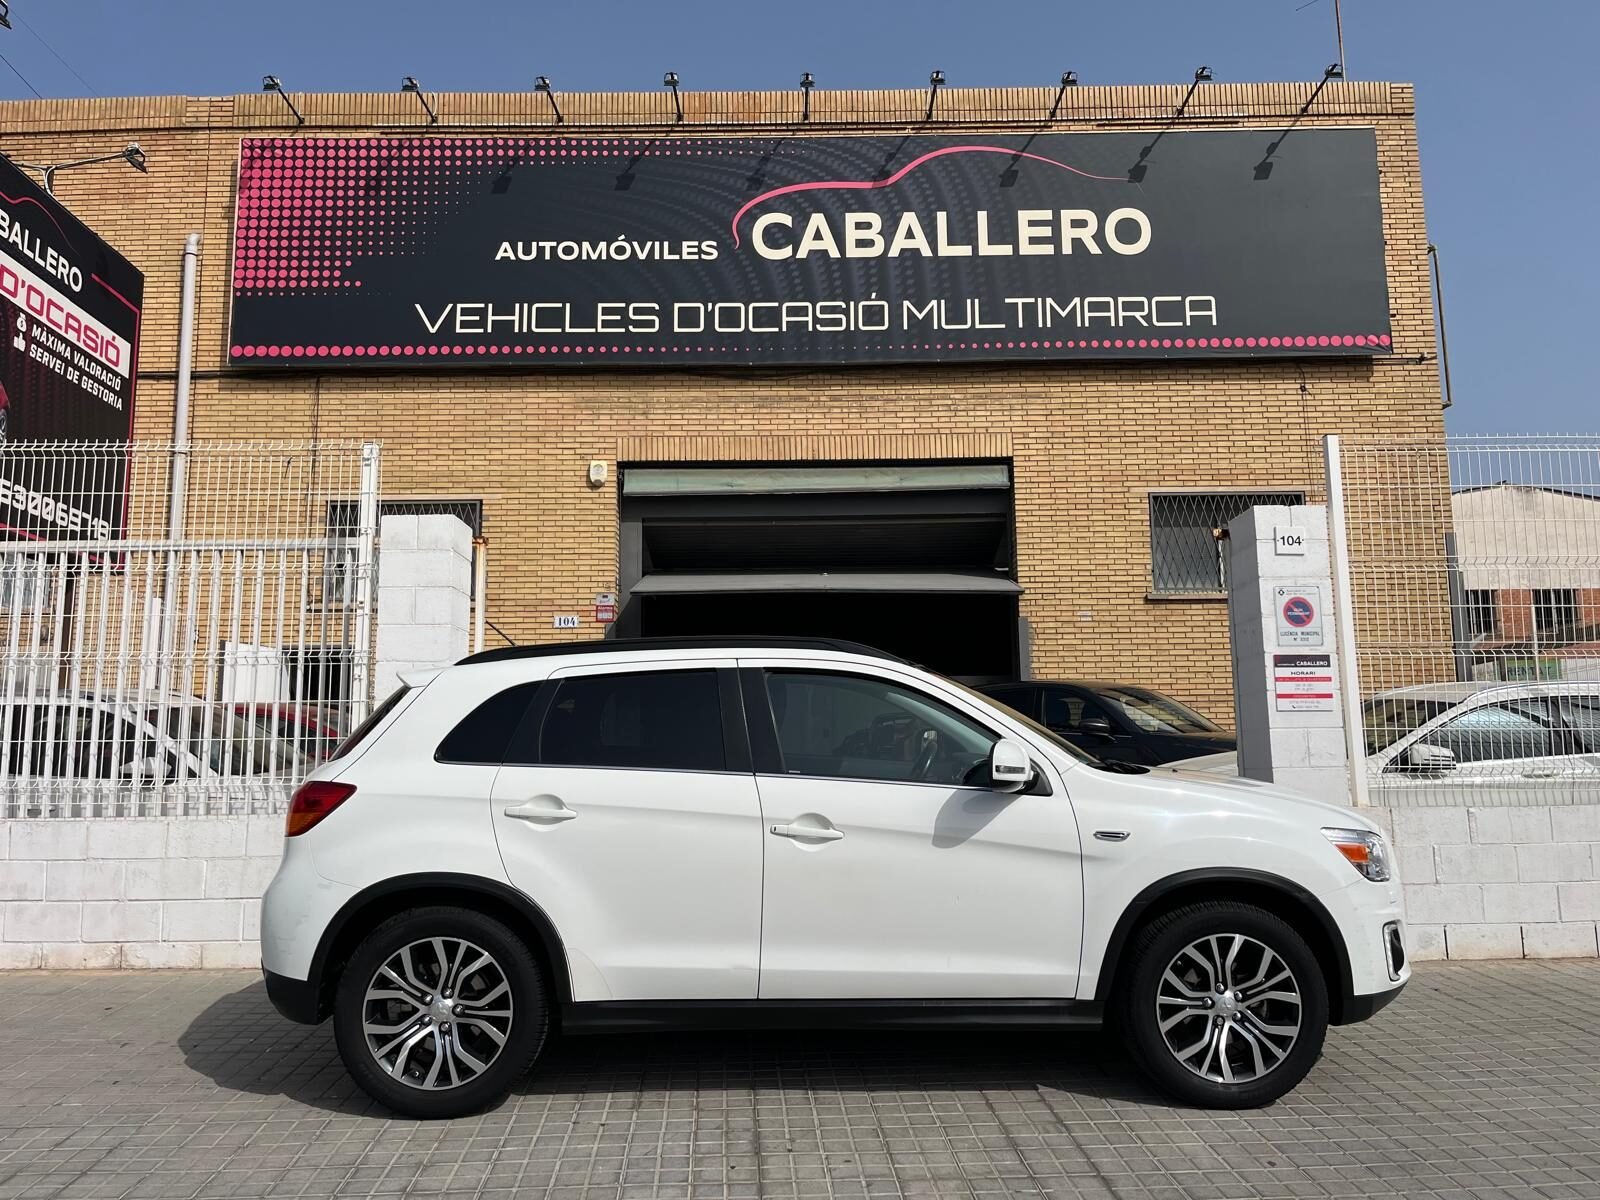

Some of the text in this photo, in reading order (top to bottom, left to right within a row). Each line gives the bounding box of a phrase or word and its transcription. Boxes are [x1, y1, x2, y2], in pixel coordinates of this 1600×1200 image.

[494, 207, 1152, 261] AUTOMÓVILES CABALLERO
[414, 292, 1218, 334] VEHICLES D'OCASIÓ MULTIMARCA
[29, 343, 123, 411] SERVEI DE GESTORIA
[31, 324, 122, 392] MÀXIMA VALORACIÓ
[1280, 535, 1302, 546] 104
[558, 617, 576, 626] 104
